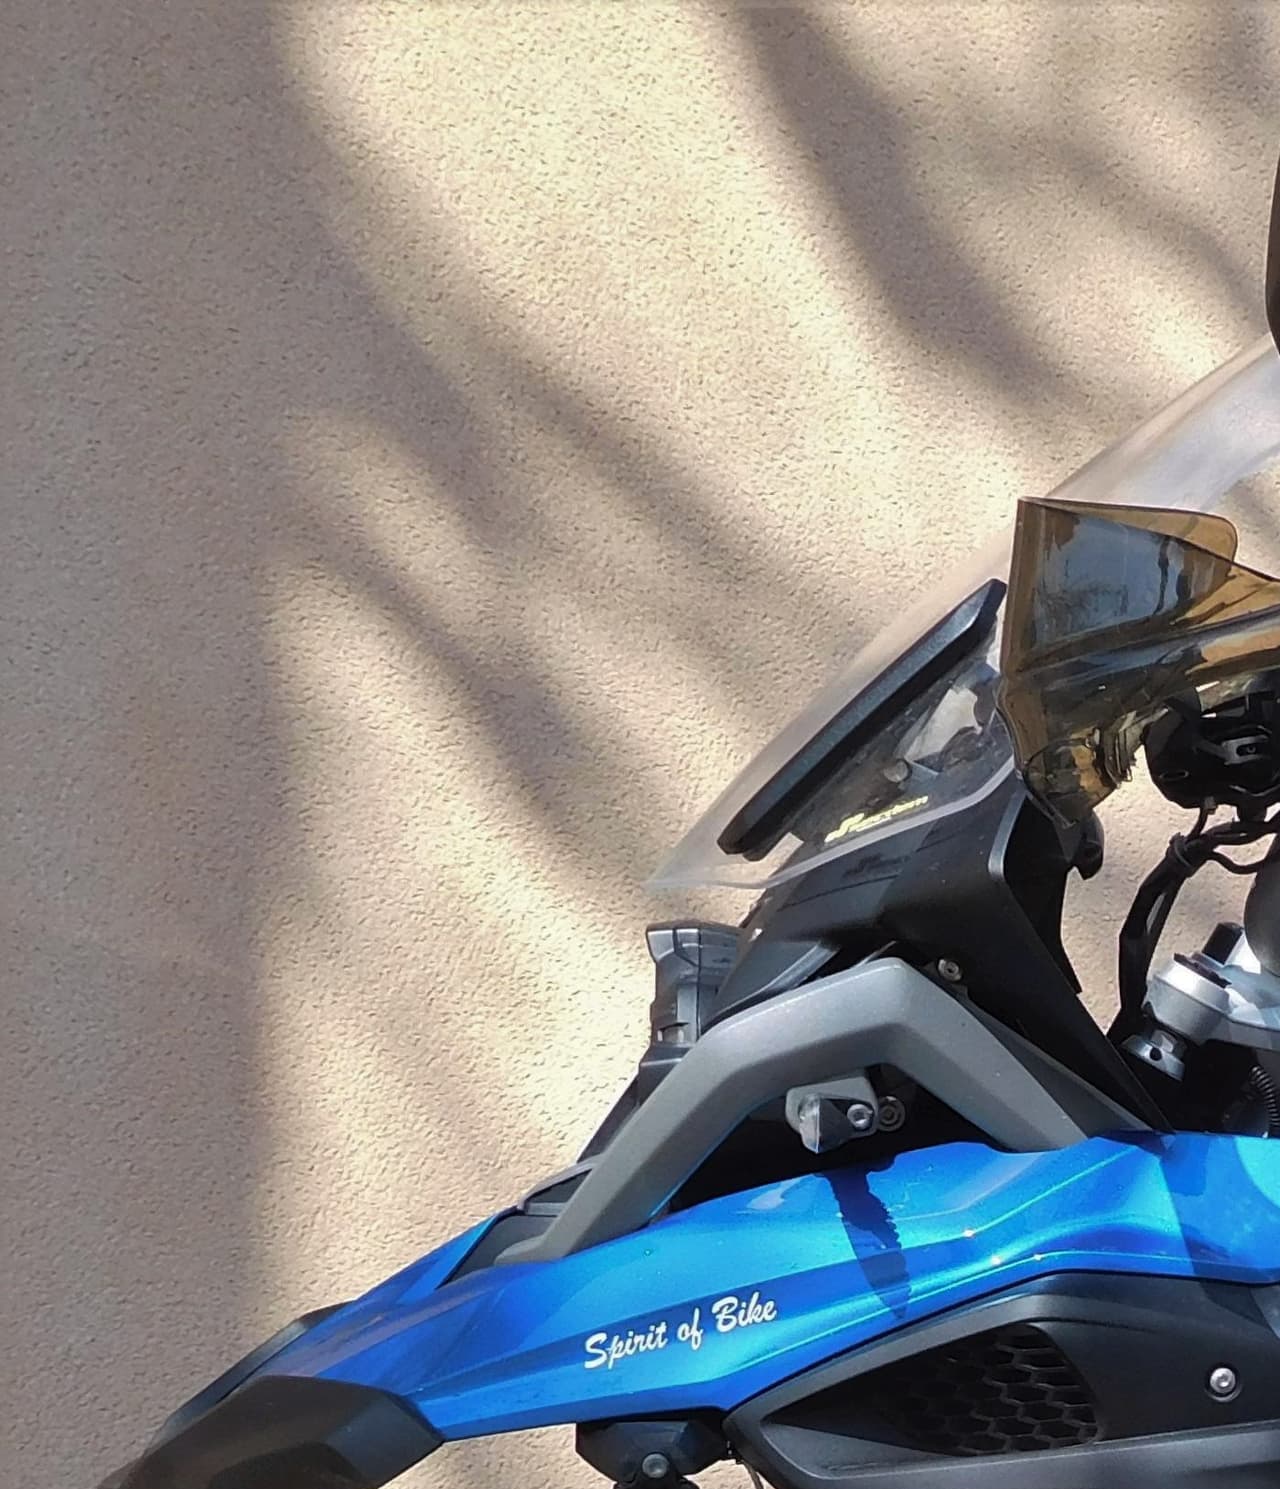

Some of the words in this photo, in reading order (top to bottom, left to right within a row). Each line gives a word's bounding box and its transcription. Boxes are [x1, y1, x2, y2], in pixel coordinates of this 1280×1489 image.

[584, 1331, 669, 1370] Spirit
[676, 1308, 704, 1350] of
[711, 1291, 777, 1333] Bike
